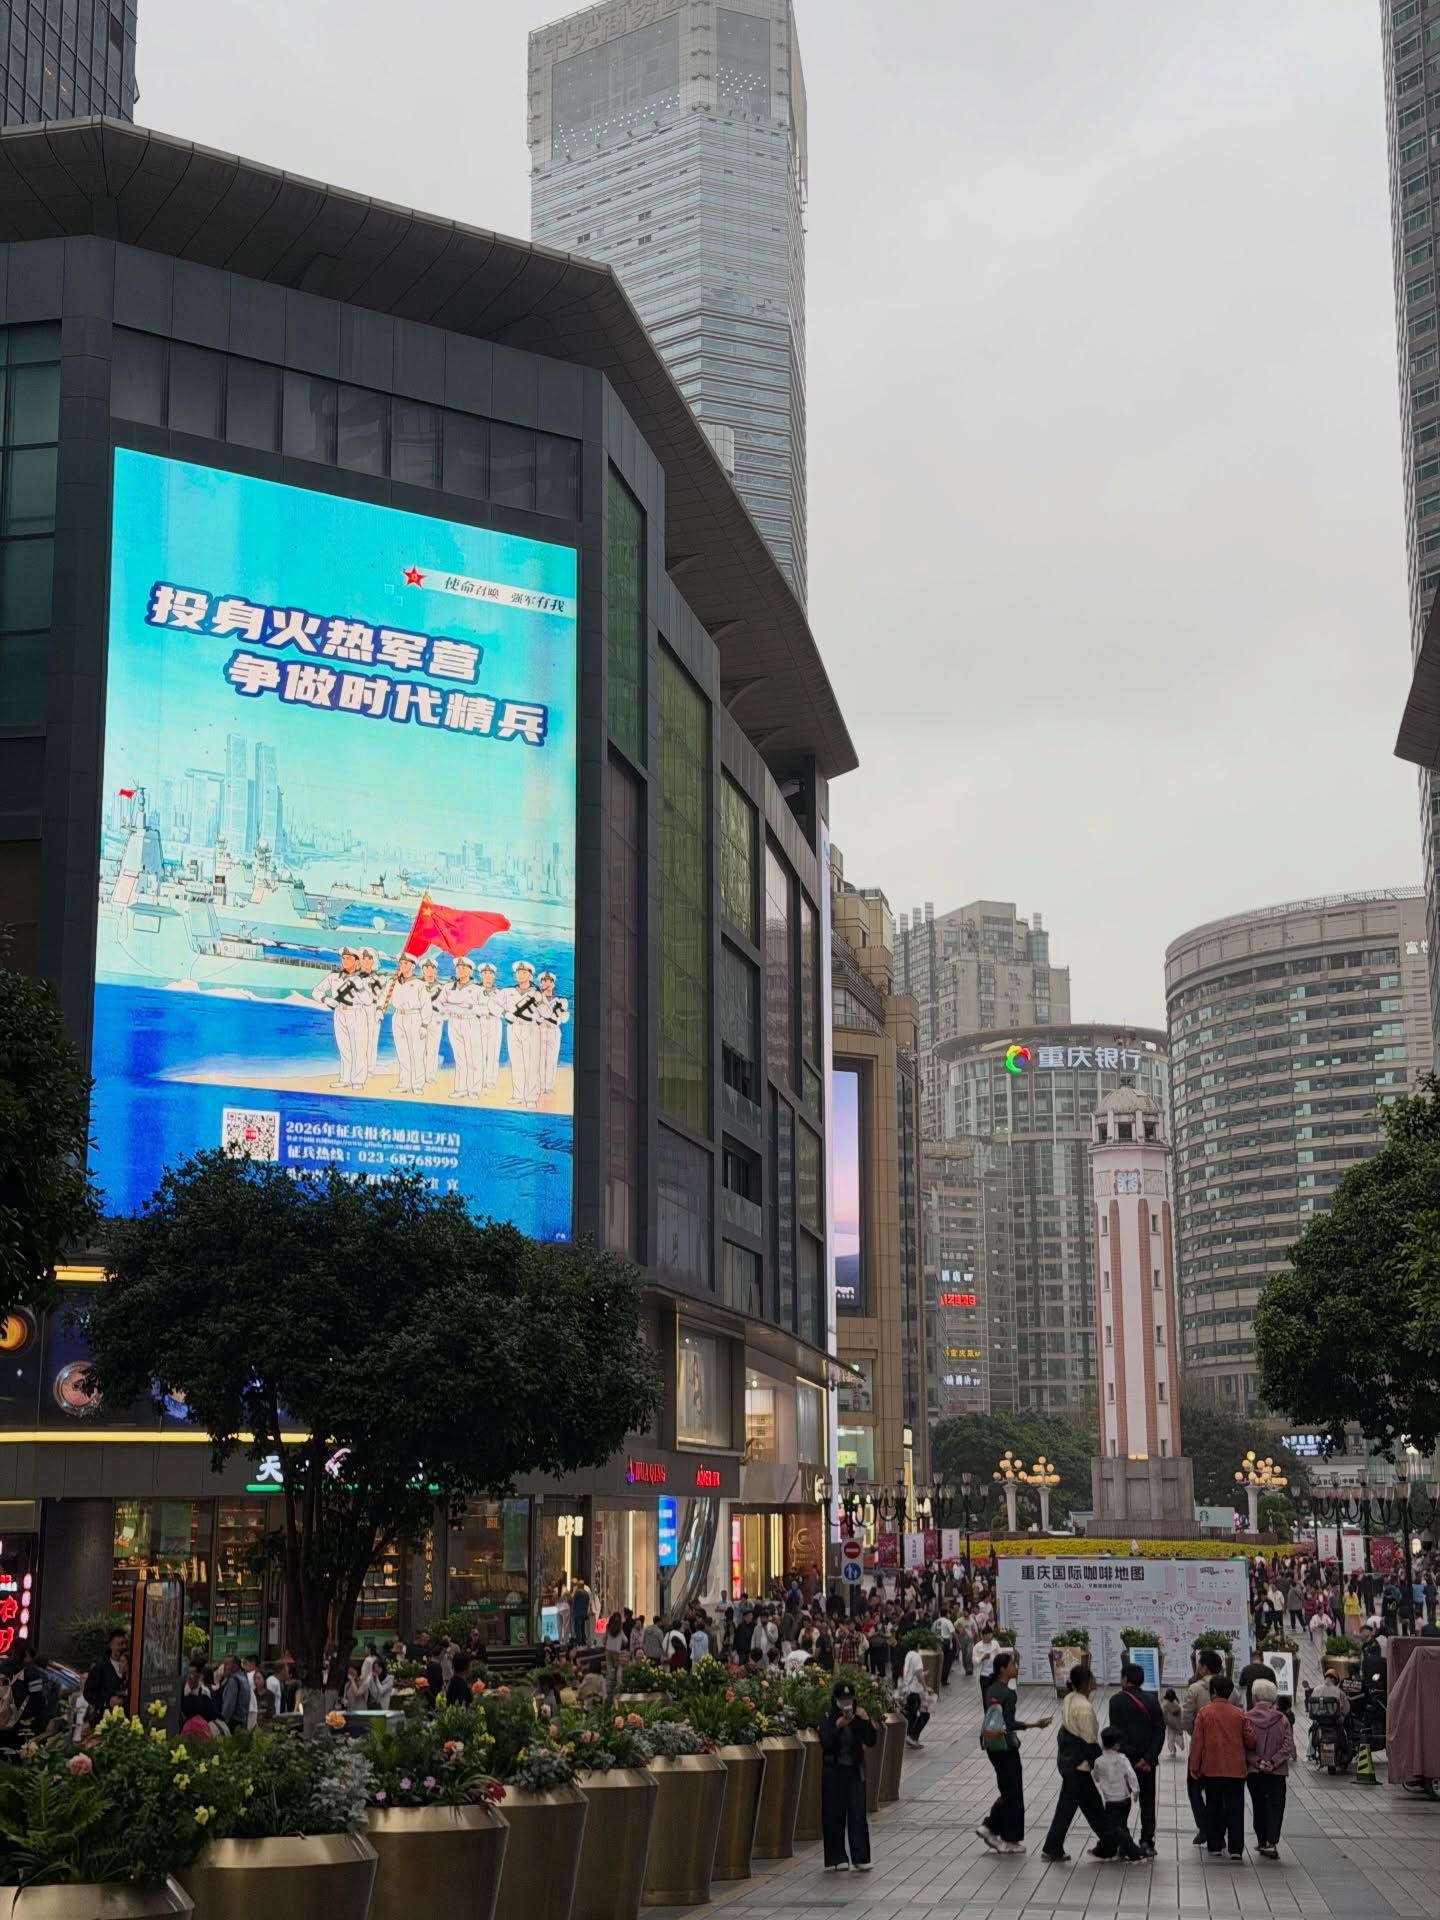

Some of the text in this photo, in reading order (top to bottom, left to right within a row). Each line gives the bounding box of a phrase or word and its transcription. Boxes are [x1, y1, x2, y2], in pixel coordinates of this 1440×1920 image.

[444, 576, 565, 613] 使命召唤 强军有我
[148, 583, 482, 683] 投身火热军营
[226, 652, 547, 745] 争做时代精兵
[1037, 1045, 1141, 1071] 重庆银行
[285, 1121, 461, 1147] 2026年征兵报名通道已开启
[358, 1150, 459, 1169] 023-68768999
[1021, 1564, 1145, 1582] 重庆国际咖啡地图
